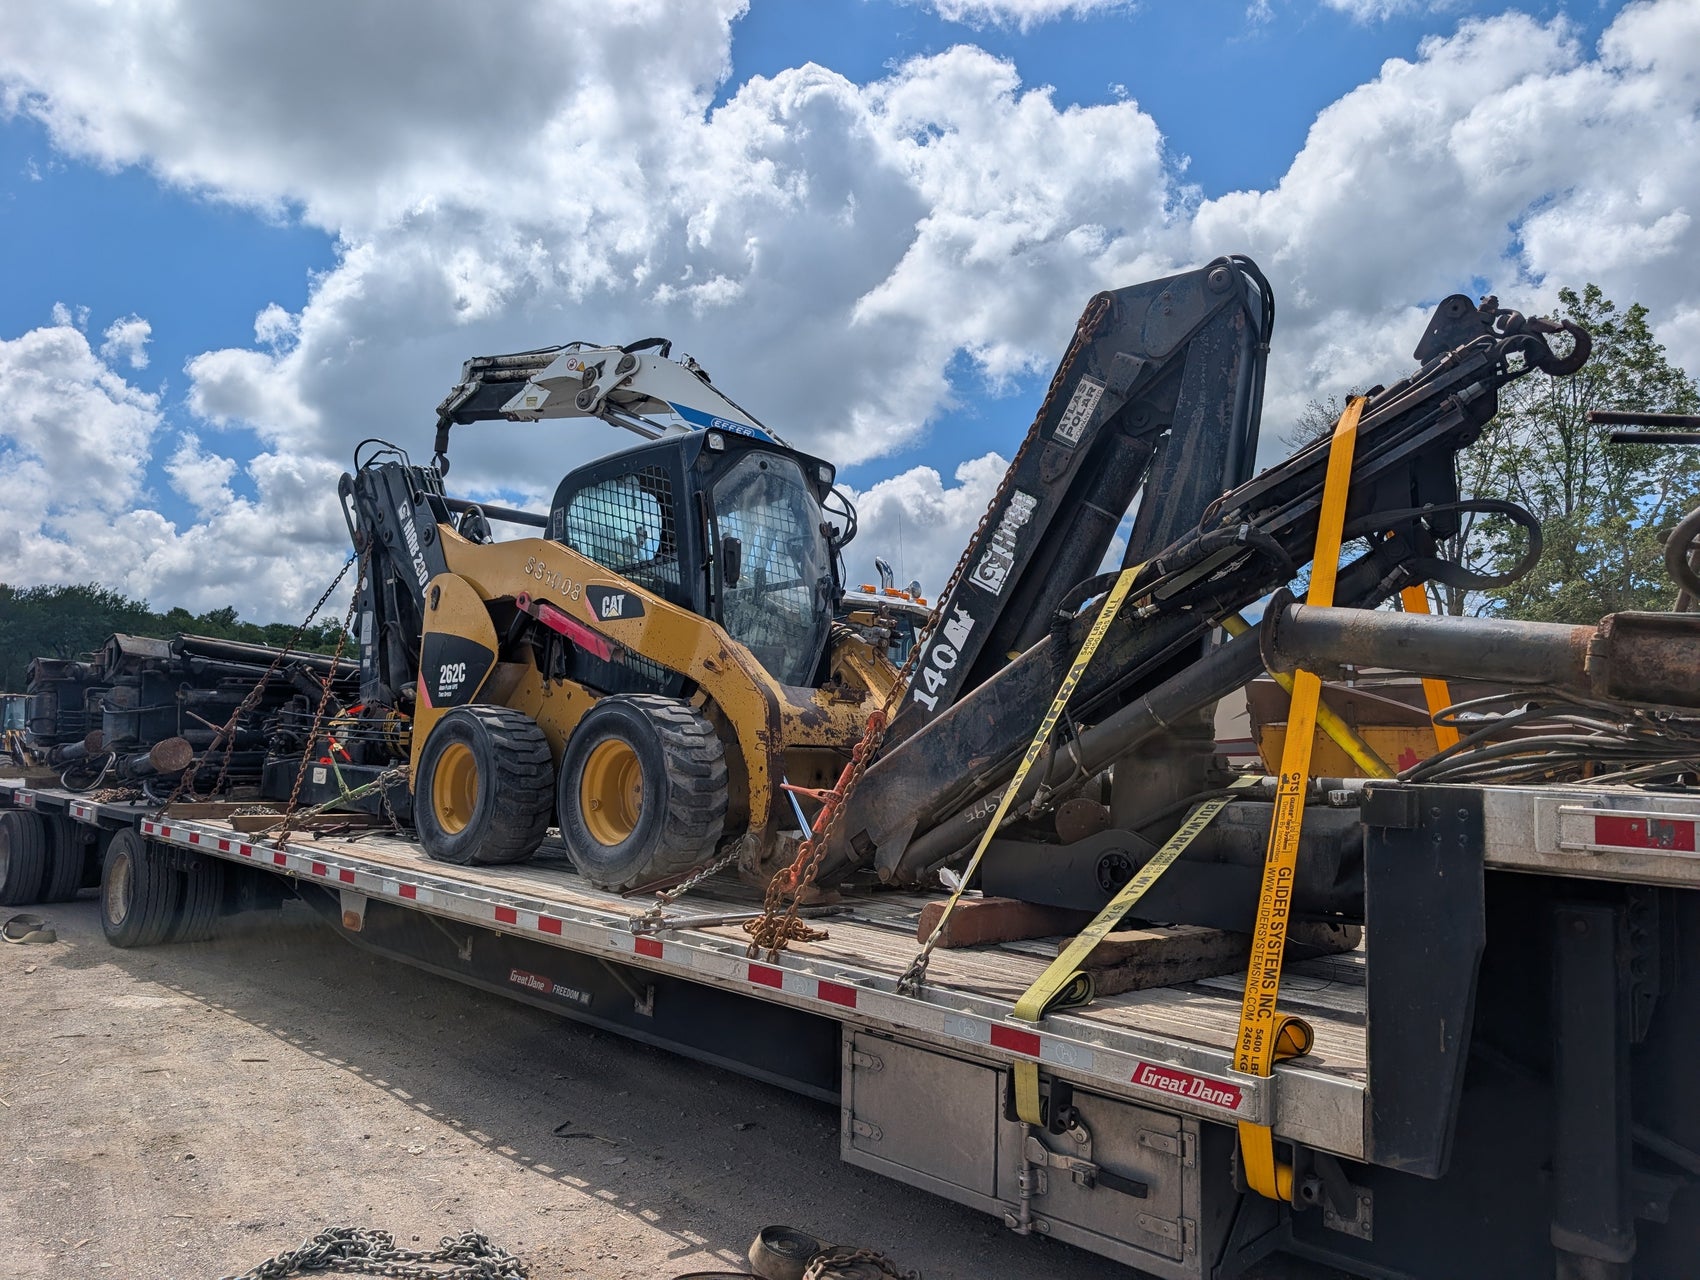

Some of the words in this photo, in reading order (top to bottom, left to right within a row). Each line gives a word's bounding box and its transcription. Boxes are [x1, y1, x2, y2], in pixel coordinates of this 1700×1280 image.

[1059, 383, 1087, 433] ATLAS
[1065, 386, 1096, 438] POLAR
[1074, 411, 1091, 440] COMPANY
[1089, 389, 1103, 411] LIMITED
[714, 419, 752, 437] EFFER
[403, 518, 420, 557] HIAB
[602, 594, 625, 618] CAT
[1102, 597, 1121, 618] WLL
[440, 662, 466, 684] 262C
[913, 644, 957, 712] 140
[1290, 772, 1301, 792] GTS
[1167, 803, 1220, 851] BULWARK
[1124, 875, 1153, 896] WLL
[1272, 867, 1292, 918] GLIDER
[1245, 867, 1277, 1021] WWW.GLIDERSYSTEMSINC.COM
[1262, 919, 1288, 990] SYSTEMS
[510, 969, 529, 986] Great
[527, 975, 545, 991] Dane
[552, 984, 580, 1001] FREEDOM
[1256, 994, 1275, 1022] INC.
[1242, 1026, 1253, 1051] 2450
[1253, 1028, 1264, 1053] 5400
[1240, 1054, 1249, 1073] KG
[1140, 1066, 1188, 1094] Great
[1187, 1077, 1234, 1106] Dane
